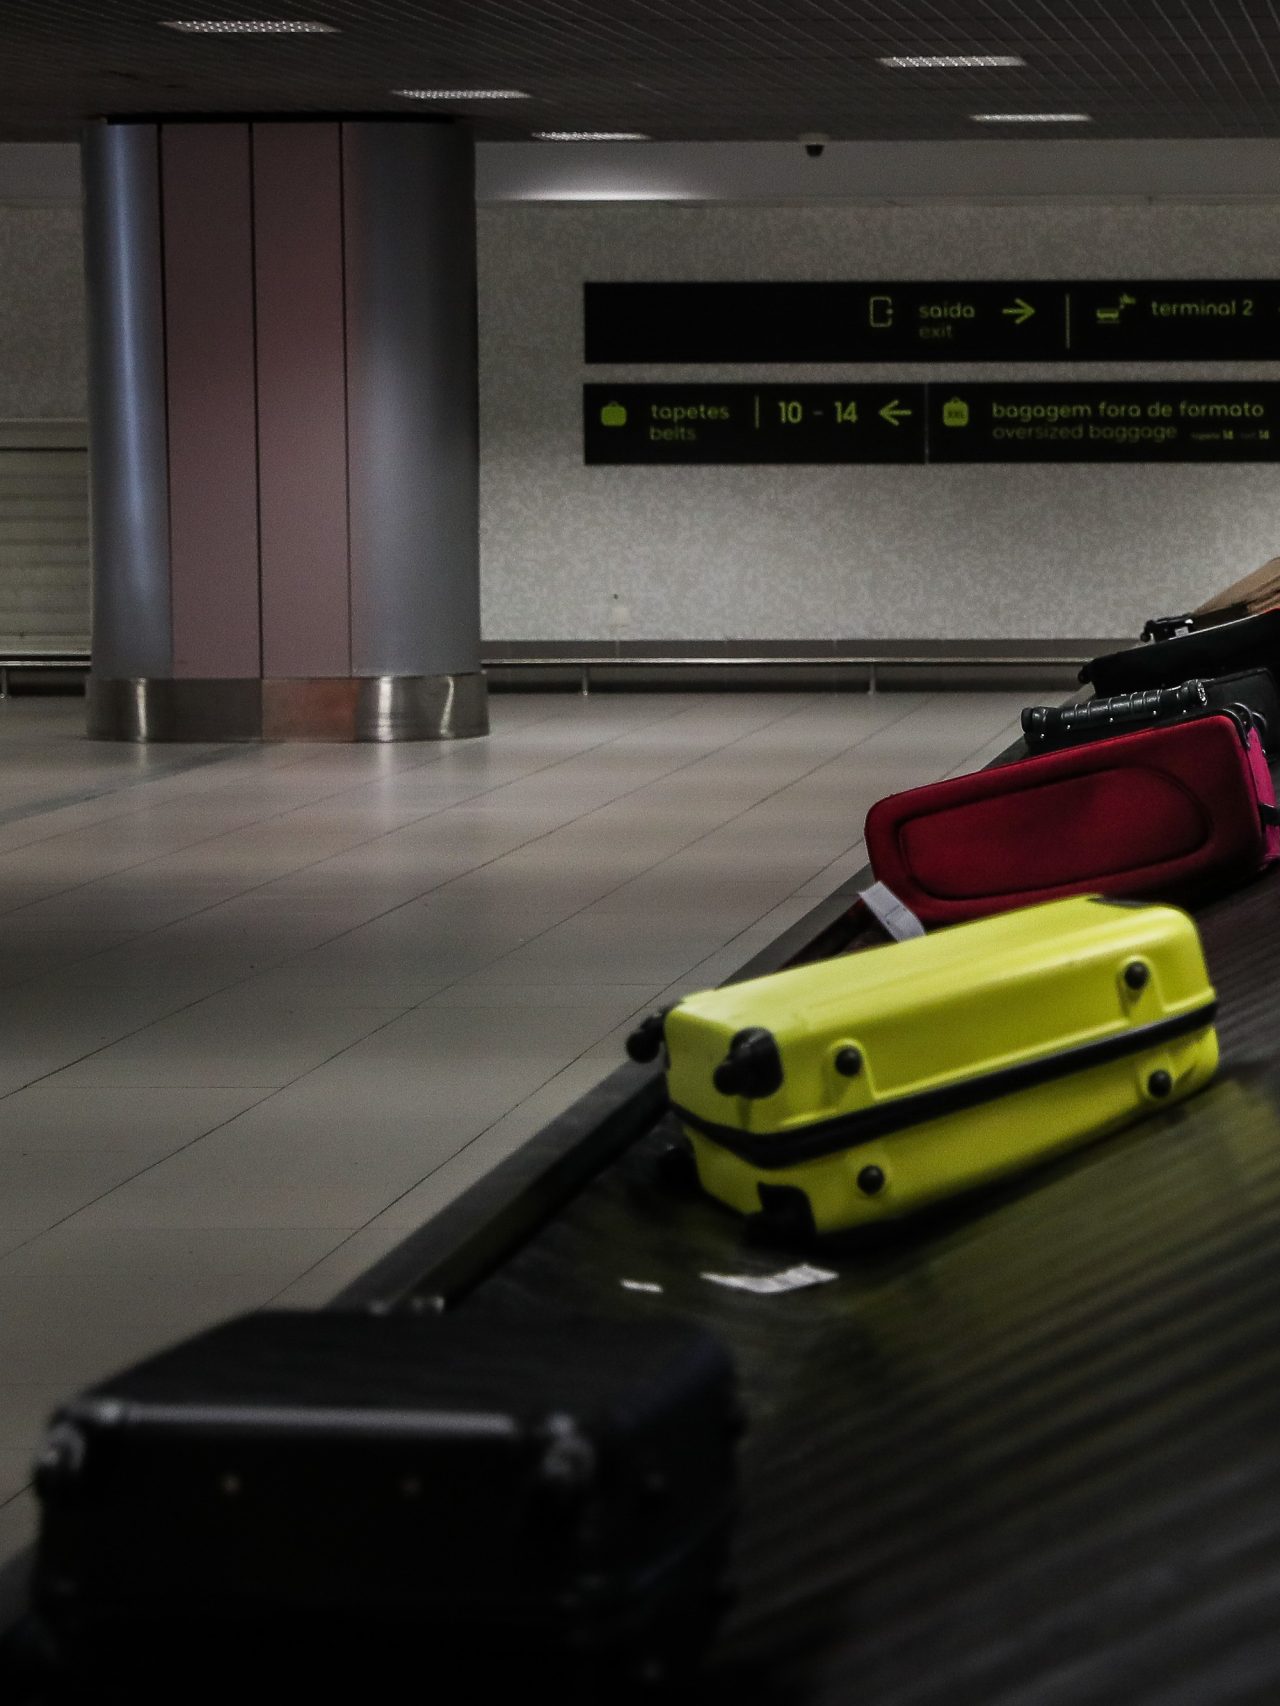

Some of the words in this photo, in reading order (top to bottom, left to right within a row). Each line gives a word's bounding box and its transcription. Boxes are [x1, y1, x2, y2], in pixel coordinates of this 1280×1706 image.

[1151, 299, 1238, 318] terminal
[1242, 298, 1254, 318] 2
[918, 323, 954, 340] exit
[651, 403, 731, 423] tapetes
[778, 401, 803, 424] 10
[834, 401, 859, 424] 14
[991, 401, 1093, 423] bagagem
[1098, 401, 1142, 418] fora
[1147, 401, 1174, 418] de
[1179, 400, 1266, 418] formato
[649, 424, 698, 442] belts
[991, 423, 1085, 441] oversized
[1088, 423, 1179, 444] baggage
